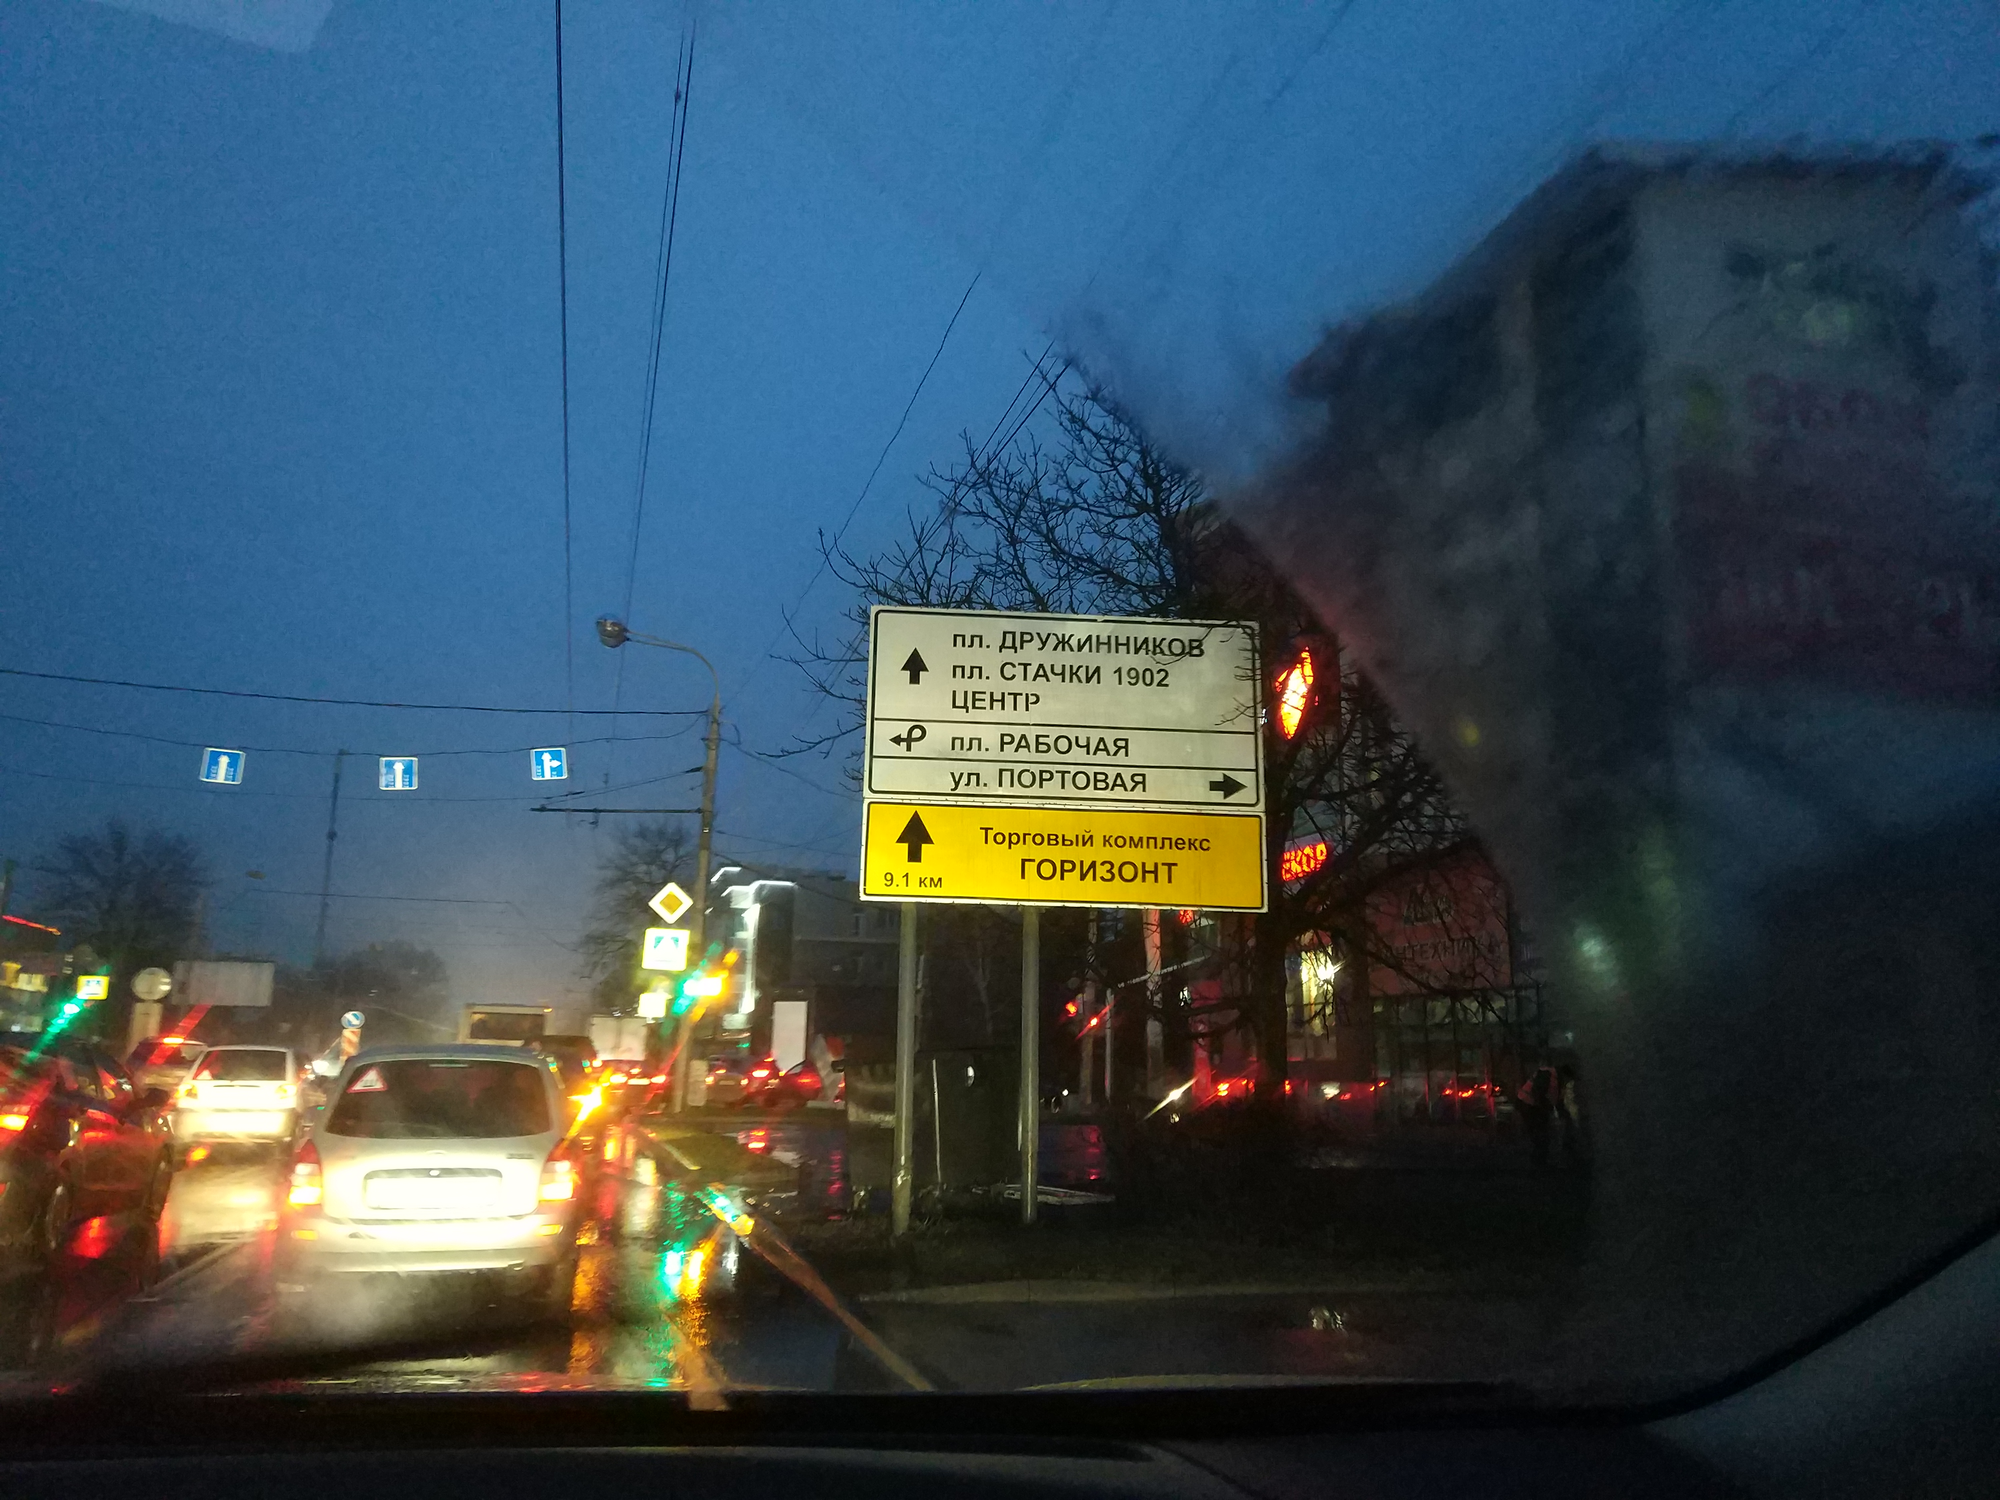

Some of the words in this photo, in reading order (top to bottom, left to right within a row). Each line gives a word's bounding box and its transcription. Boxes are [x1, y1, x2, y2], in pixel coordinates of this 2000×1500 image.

[953, 633, 991, 649] пл.
[999, 630, 1205, 657] ДРУЖИННИКОВ
[953, 665, 990, 680] пл.
[1000, 661, 1101, 684] СТАЧКИ
[1114, 665, 1169, 687] 1902
[952, 690, 1040, 713] ЦЕНТР
[951, 737, 989, 751] пл.
[1000, 733, 1129, 757] РАБОЧАЯ
[950, 772, 987, 791] ул.
[998, 767, 1147, 792] ПОРТОВАЯ
[980, 827, 1093, 849] Торговый
[1103, 835, 1210, 851] комплекс
[884, 872, 910, 888] 9.1
[919, 876, 943, 889] км
[1021, 859, 1178, 883] ГОРИЗОНТ
